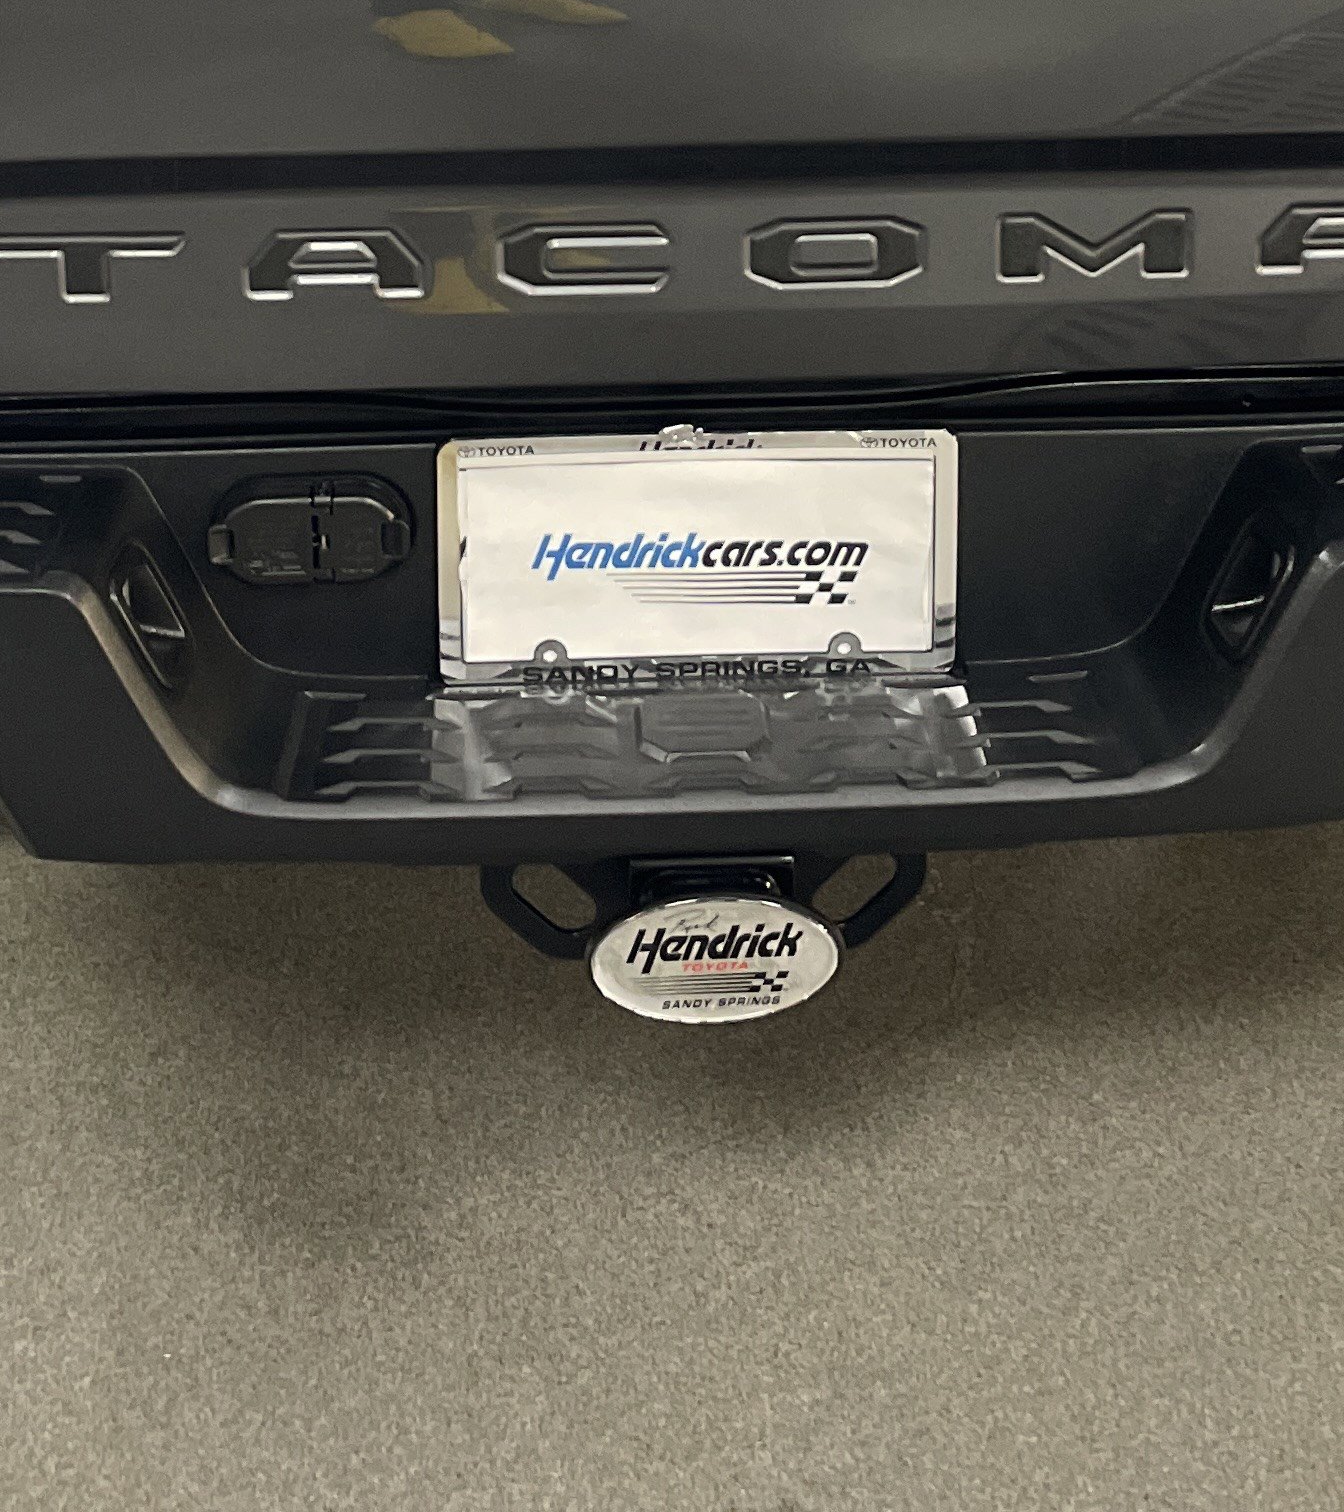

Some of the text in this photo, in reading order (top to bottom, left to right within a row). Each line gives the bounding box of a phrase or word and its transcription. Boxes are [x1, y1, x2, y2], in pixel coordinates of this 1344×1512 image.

[880, 437, 937, 448] TOYOTA
[478, 445, 535, 456] TOYOTA
[531, 533, 869, 580] Hendrickcars.com
[523, 663, 640, 684] SANDY
[826, 658, 871, 675] GA
[626, 922, 803, 975] Hendrick
[681, 961, 750, 973] TOYOTA
[662, 995, 781, 1010] SANDY SPRINGS
